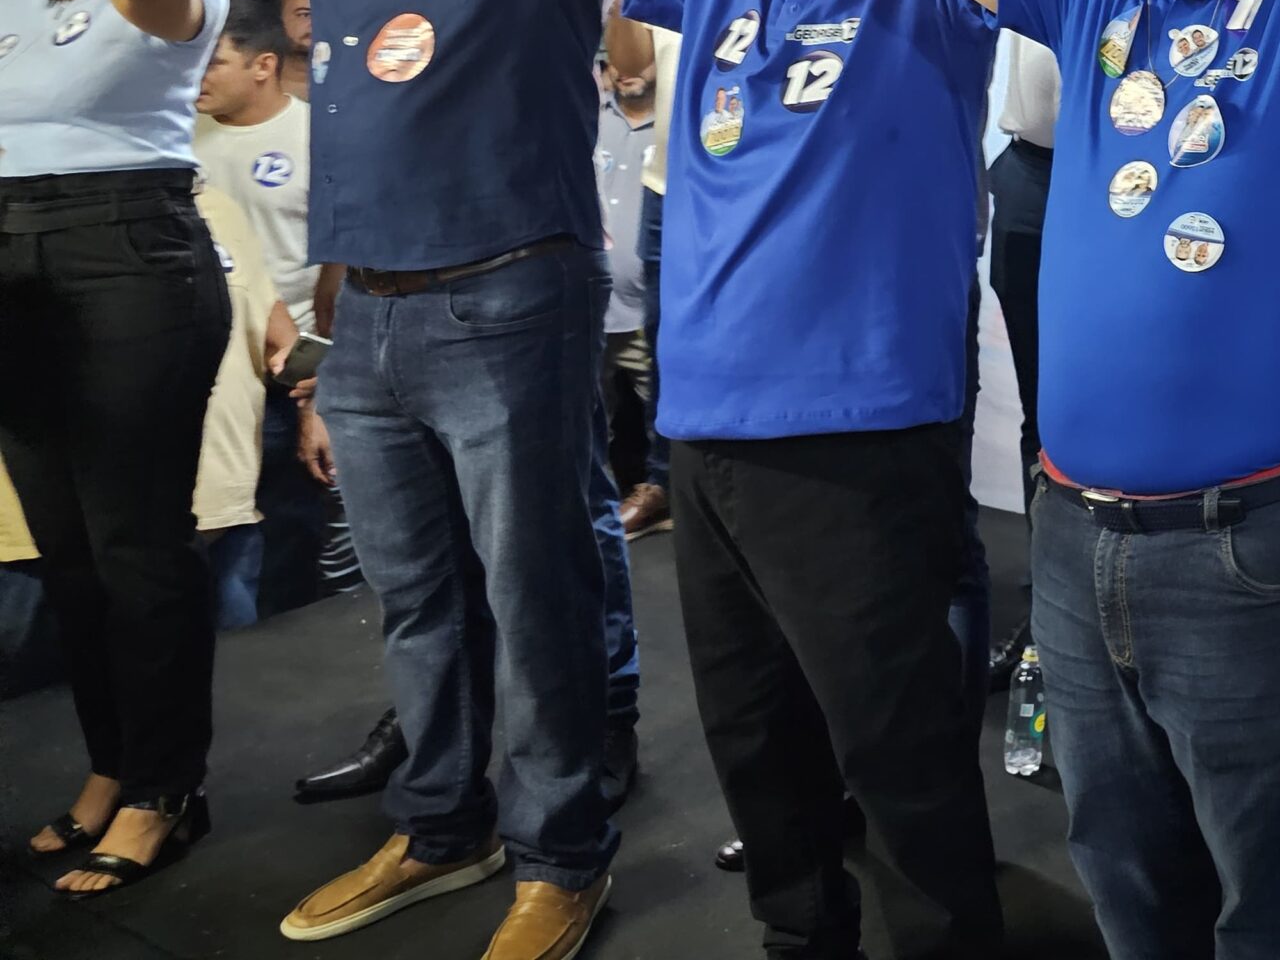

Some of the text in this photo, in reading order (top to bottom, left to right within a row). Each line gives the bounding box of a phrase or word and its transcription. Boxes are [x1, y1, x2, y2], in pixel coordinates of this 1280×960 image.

[714, 17, 761, 65] 12
[783, 60, 843, 105] 12
[254, 156, 293, 184] 12
